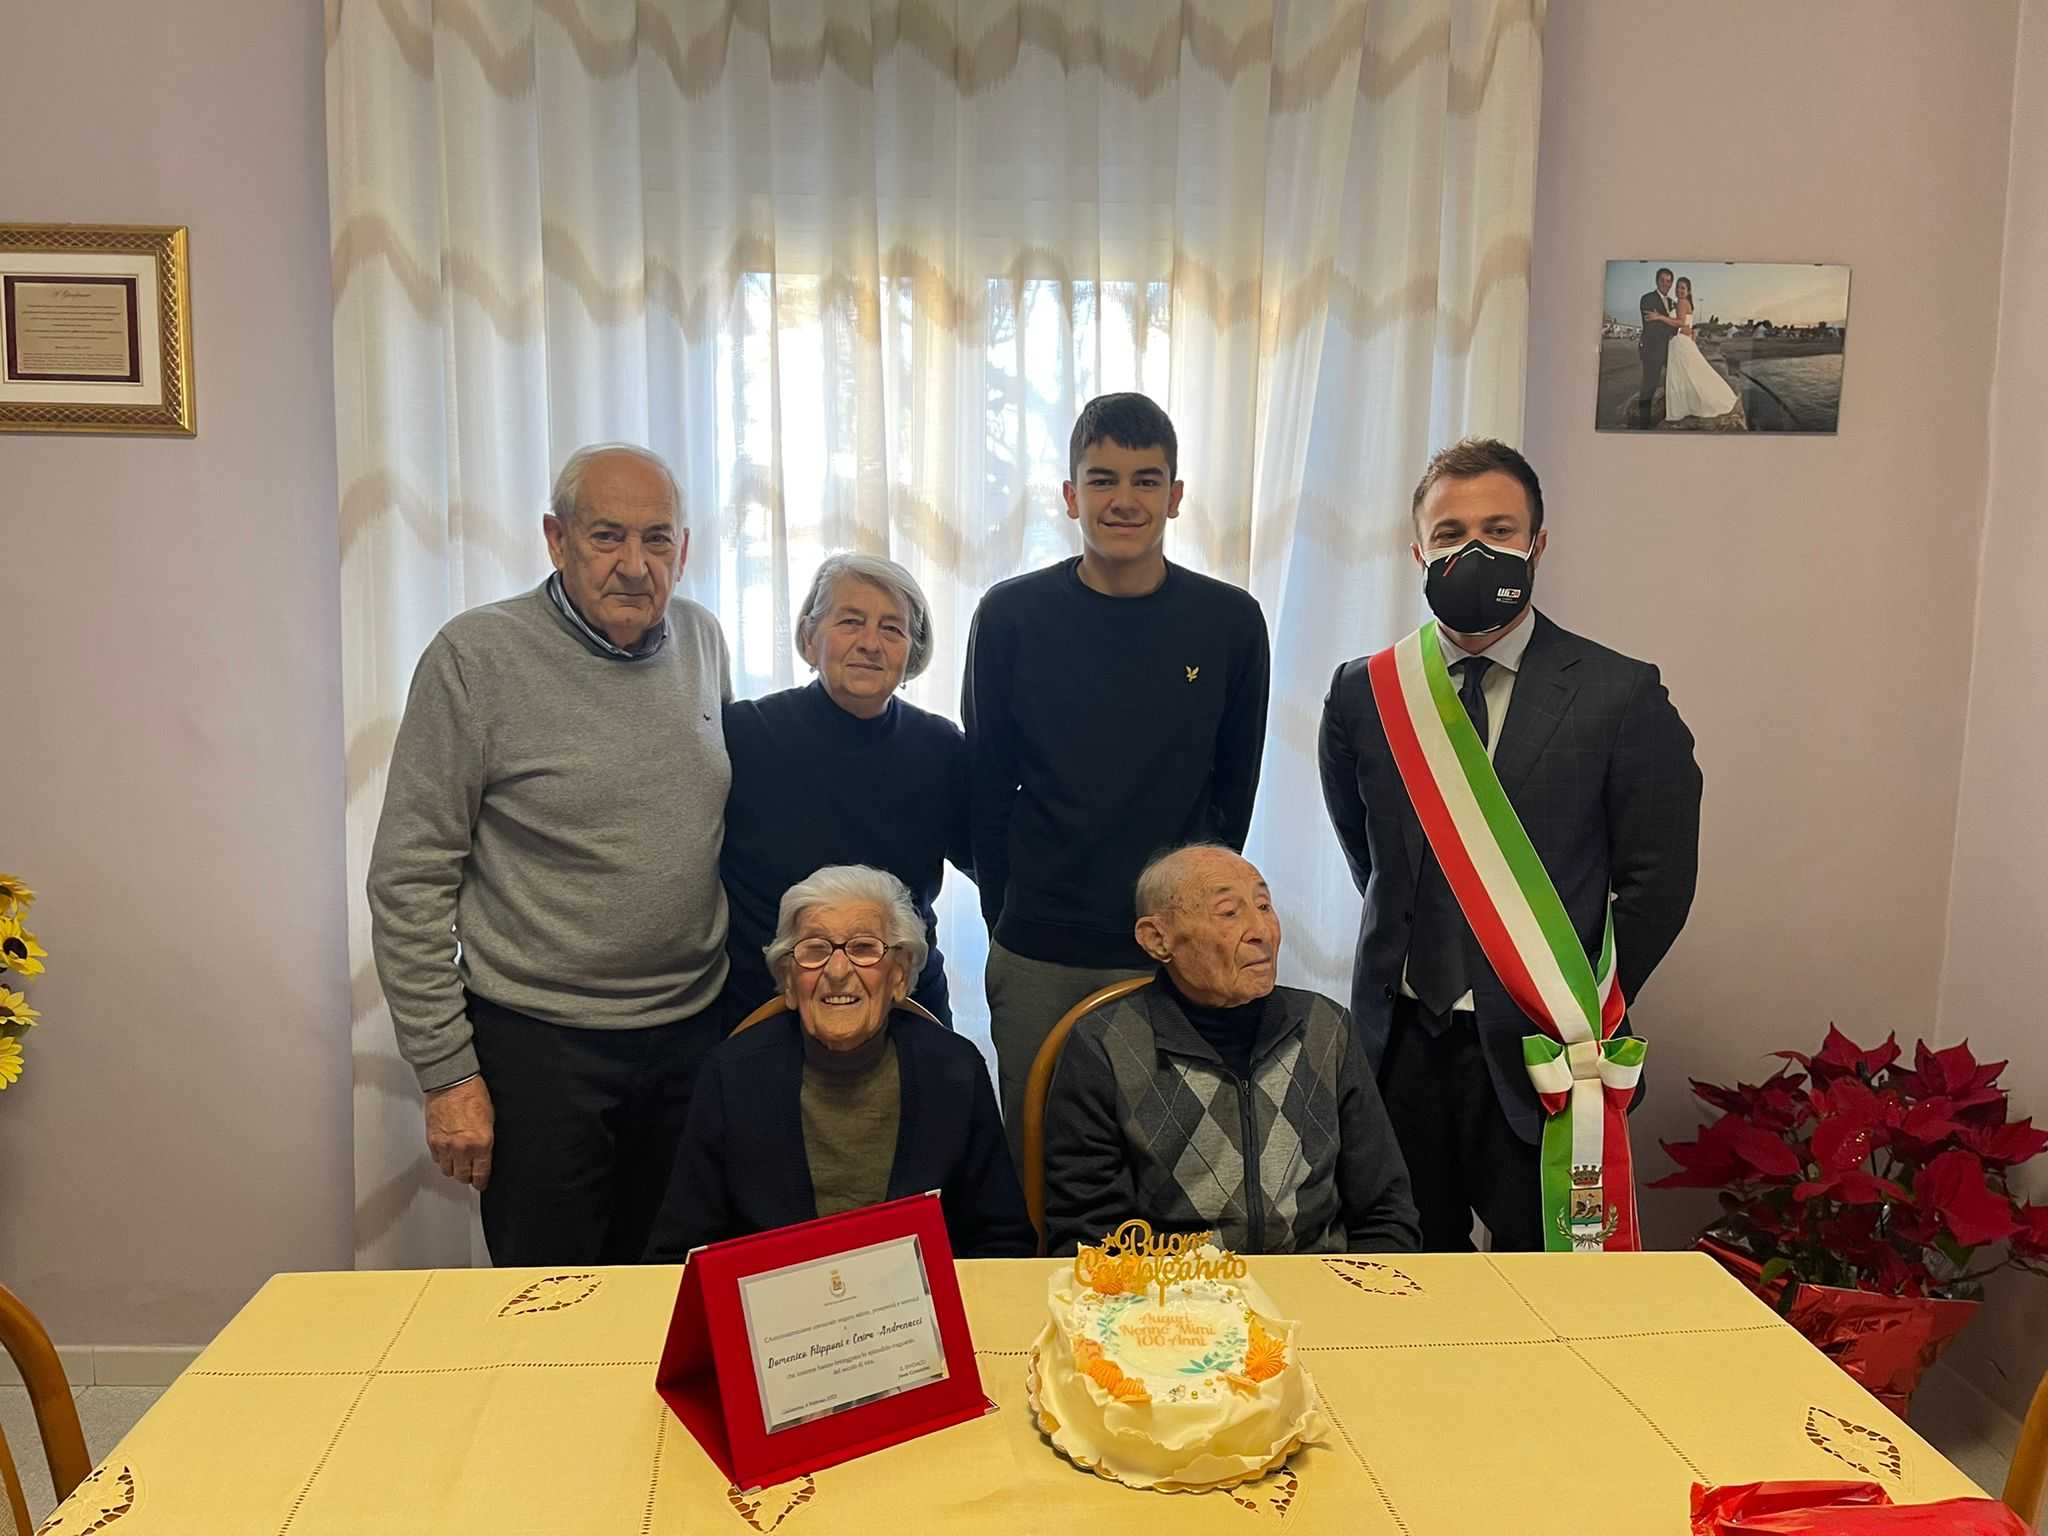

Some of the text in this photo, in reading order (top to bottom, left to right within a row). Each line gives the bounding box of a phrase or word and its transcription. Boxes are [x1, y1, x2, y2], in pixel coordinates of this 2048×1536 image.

[1114, 1218, 1205, 1258] Buon
[1074, 1248, 1248, 1290] Compleanno
[1118, 1324, 1169, 1336] Nonno
[1139, 1312, 1193, 1326] Auguri
[768, 1352, 808, 1369] Domenico
[810, 1339, 844, 1357] Filipponi
[878, 1317, 923, 1337] Andrenacci
[1137, 1334, 1209, 1347] 100 Anni
